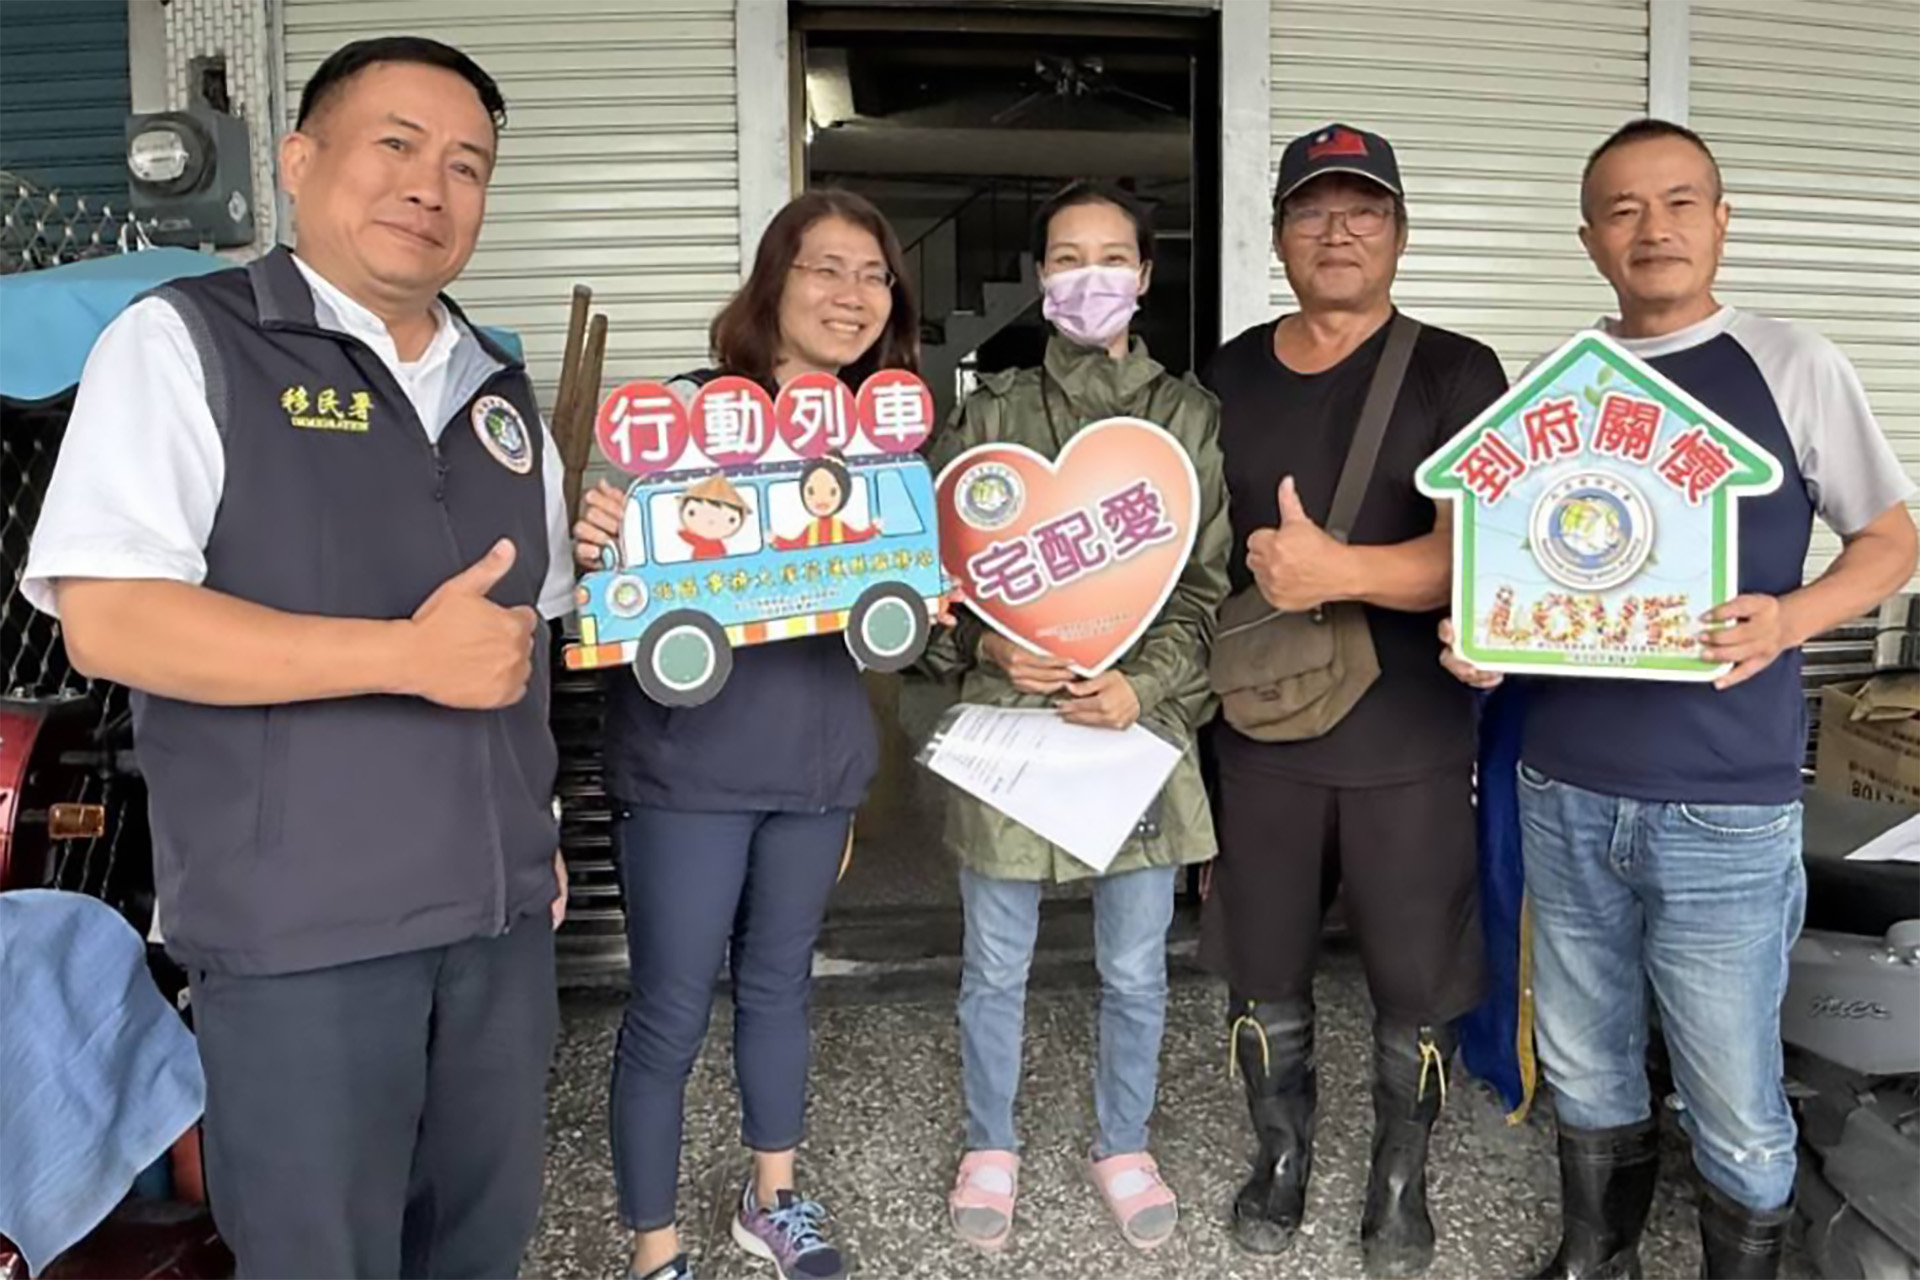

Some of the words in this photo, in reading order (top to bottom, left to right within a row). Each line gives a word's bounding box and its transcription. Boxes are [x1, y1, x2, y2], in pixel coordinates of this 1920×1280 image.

[281, 386, 374, 420] 移民署
[609, 382, 928, 465] 行動列車
[1455, 395, 1735, 504] 到府關懷
[969, 479, 1176, 603] 宅配愛
[1488, 586, 1698, 647] LOVE
